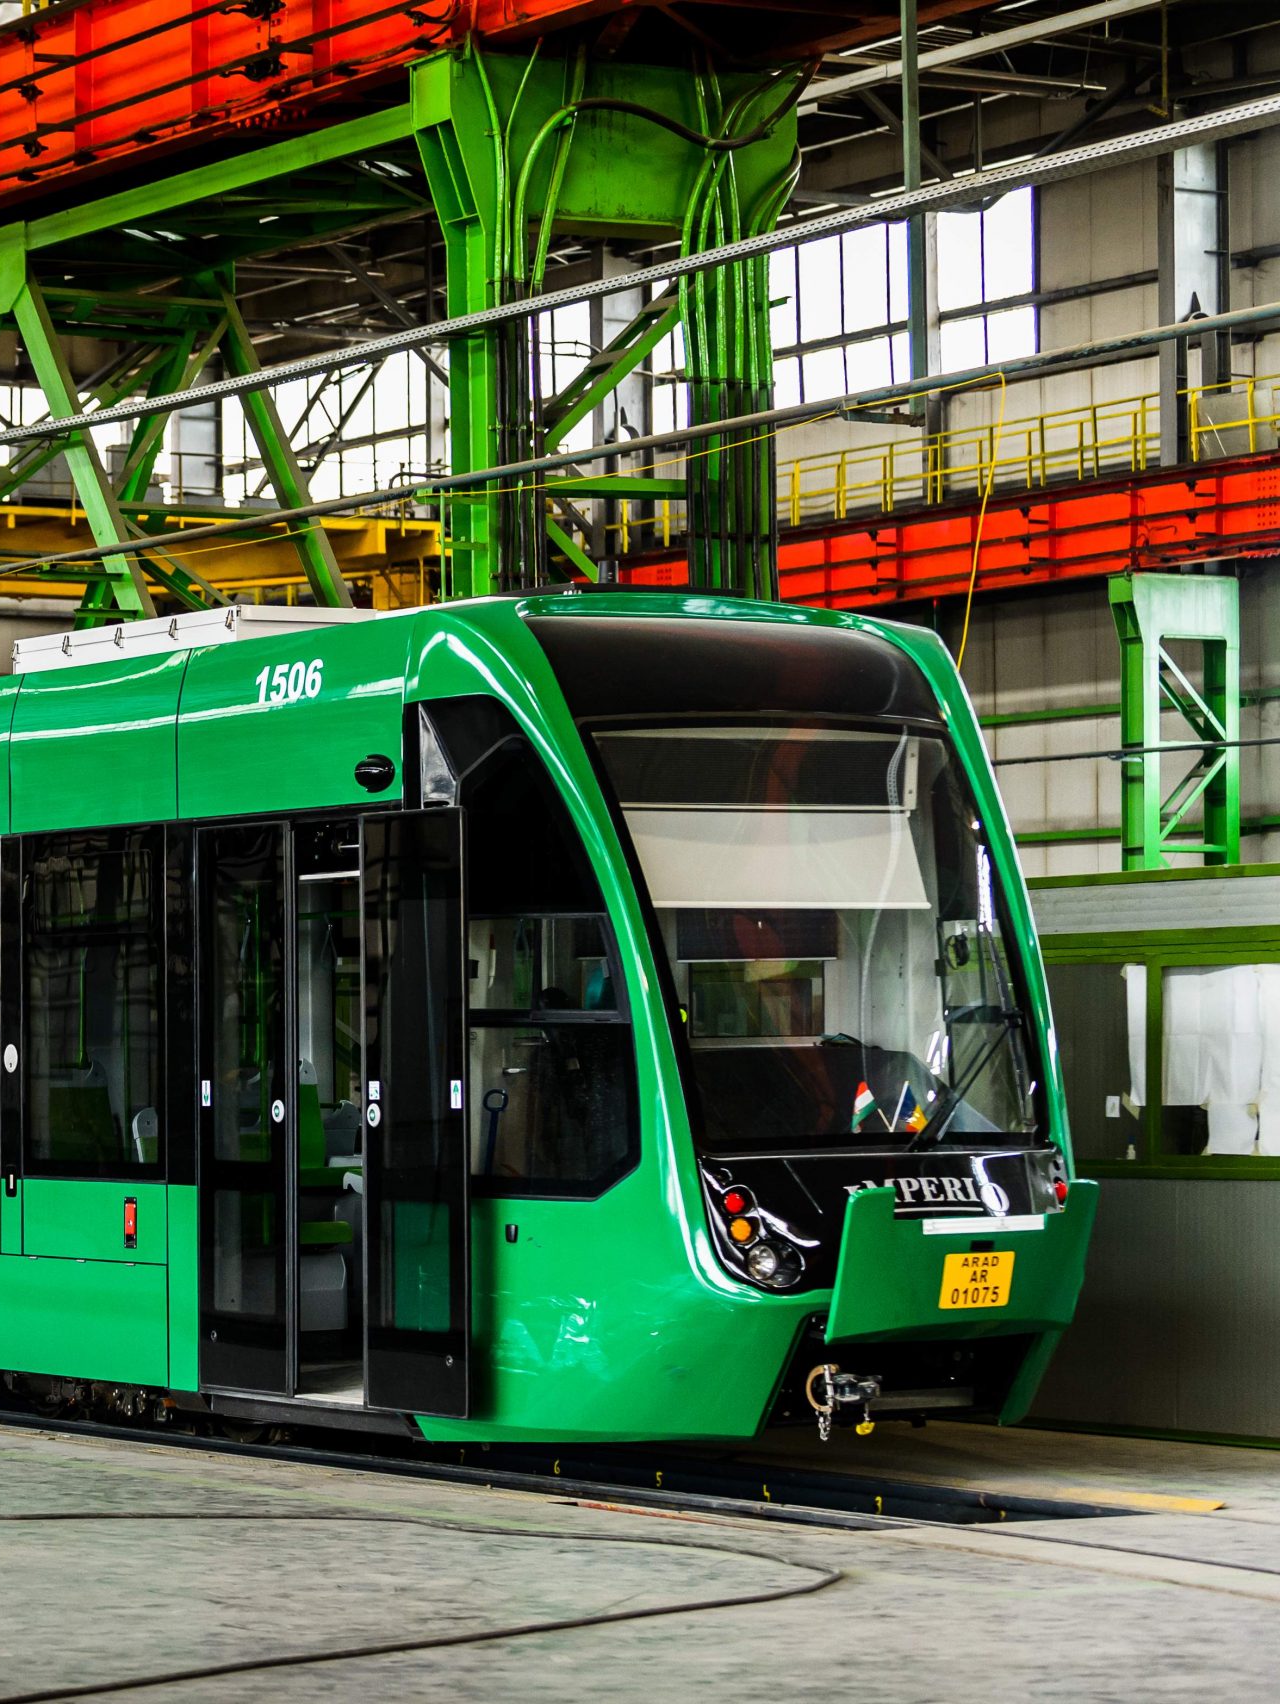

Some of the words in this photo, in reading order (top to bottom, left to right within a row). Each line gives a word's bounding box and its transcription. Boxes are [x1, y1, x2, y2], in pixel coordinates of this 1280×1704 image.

[255, 659, 324, 705] 1506
[961, 1256, 1000, 1268] ARAD
[969, 1270, 988, 1284] AR
[951, 1286, 1000, 1305] 01075
[553, 1459, 561, 1475] 6
[655, 1471, 663, 1487] 5
